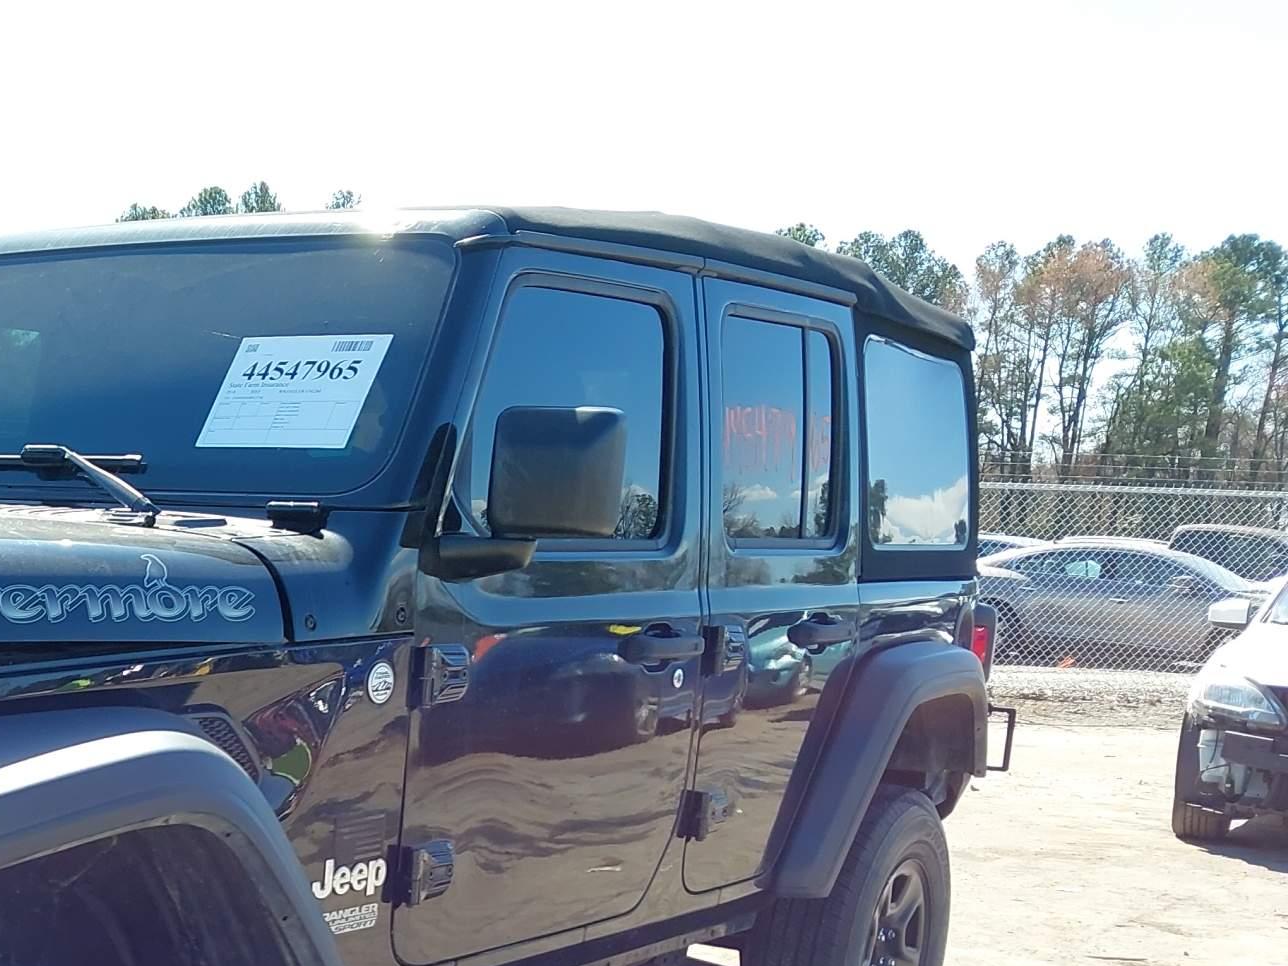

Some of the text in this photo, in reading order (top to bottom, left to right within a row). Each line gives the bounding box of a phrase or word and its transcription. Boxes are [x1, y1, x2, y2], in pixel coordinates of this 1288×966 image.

[242, 359, 363, 381] 44547965
[311, 858, 387, 899] Jeep
[331, 919, 375, 934] SPORT
